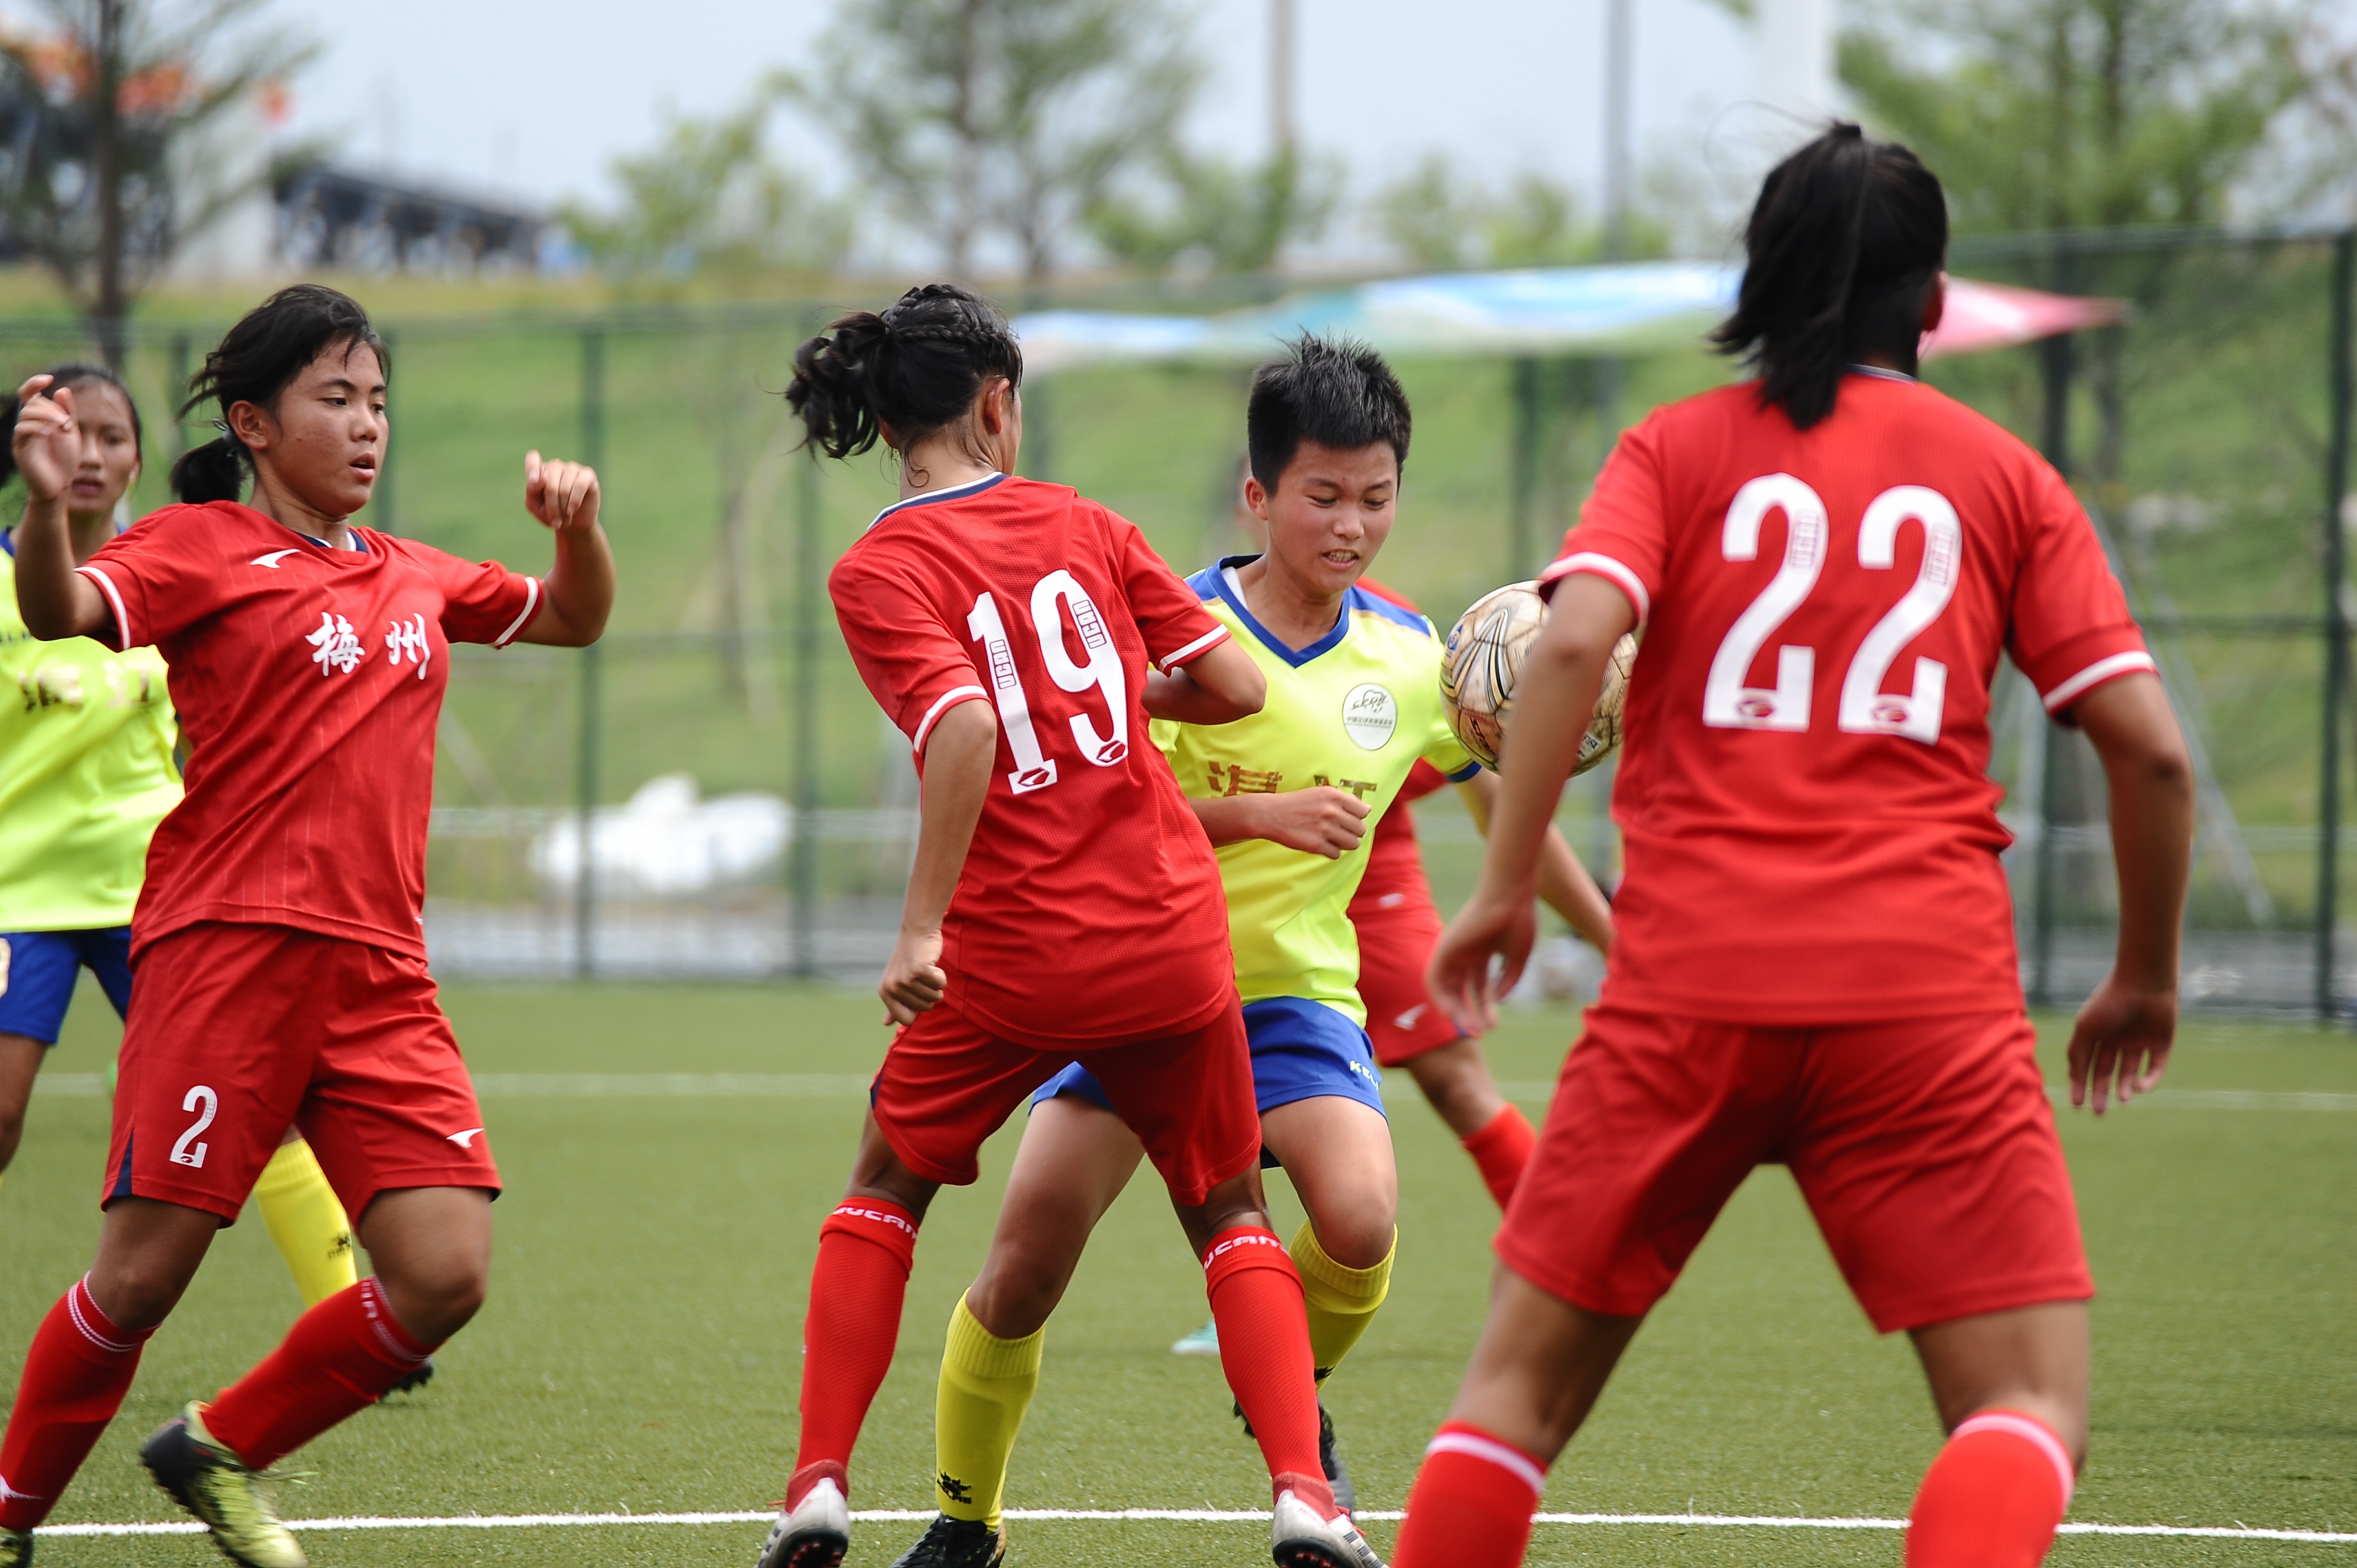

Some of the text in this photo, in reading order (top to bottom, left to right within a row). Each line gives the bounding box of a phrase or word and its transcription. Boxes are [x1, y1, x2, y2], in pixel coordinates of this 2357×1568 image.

[305, 611, 431, 680] 梅州
[1702, 472, 1963, 746] 22
[967, 569, 1128, 795] 19
[1350, 1060, 1378, 1090] KEL
[169, 1085, 218, 1168] 2
